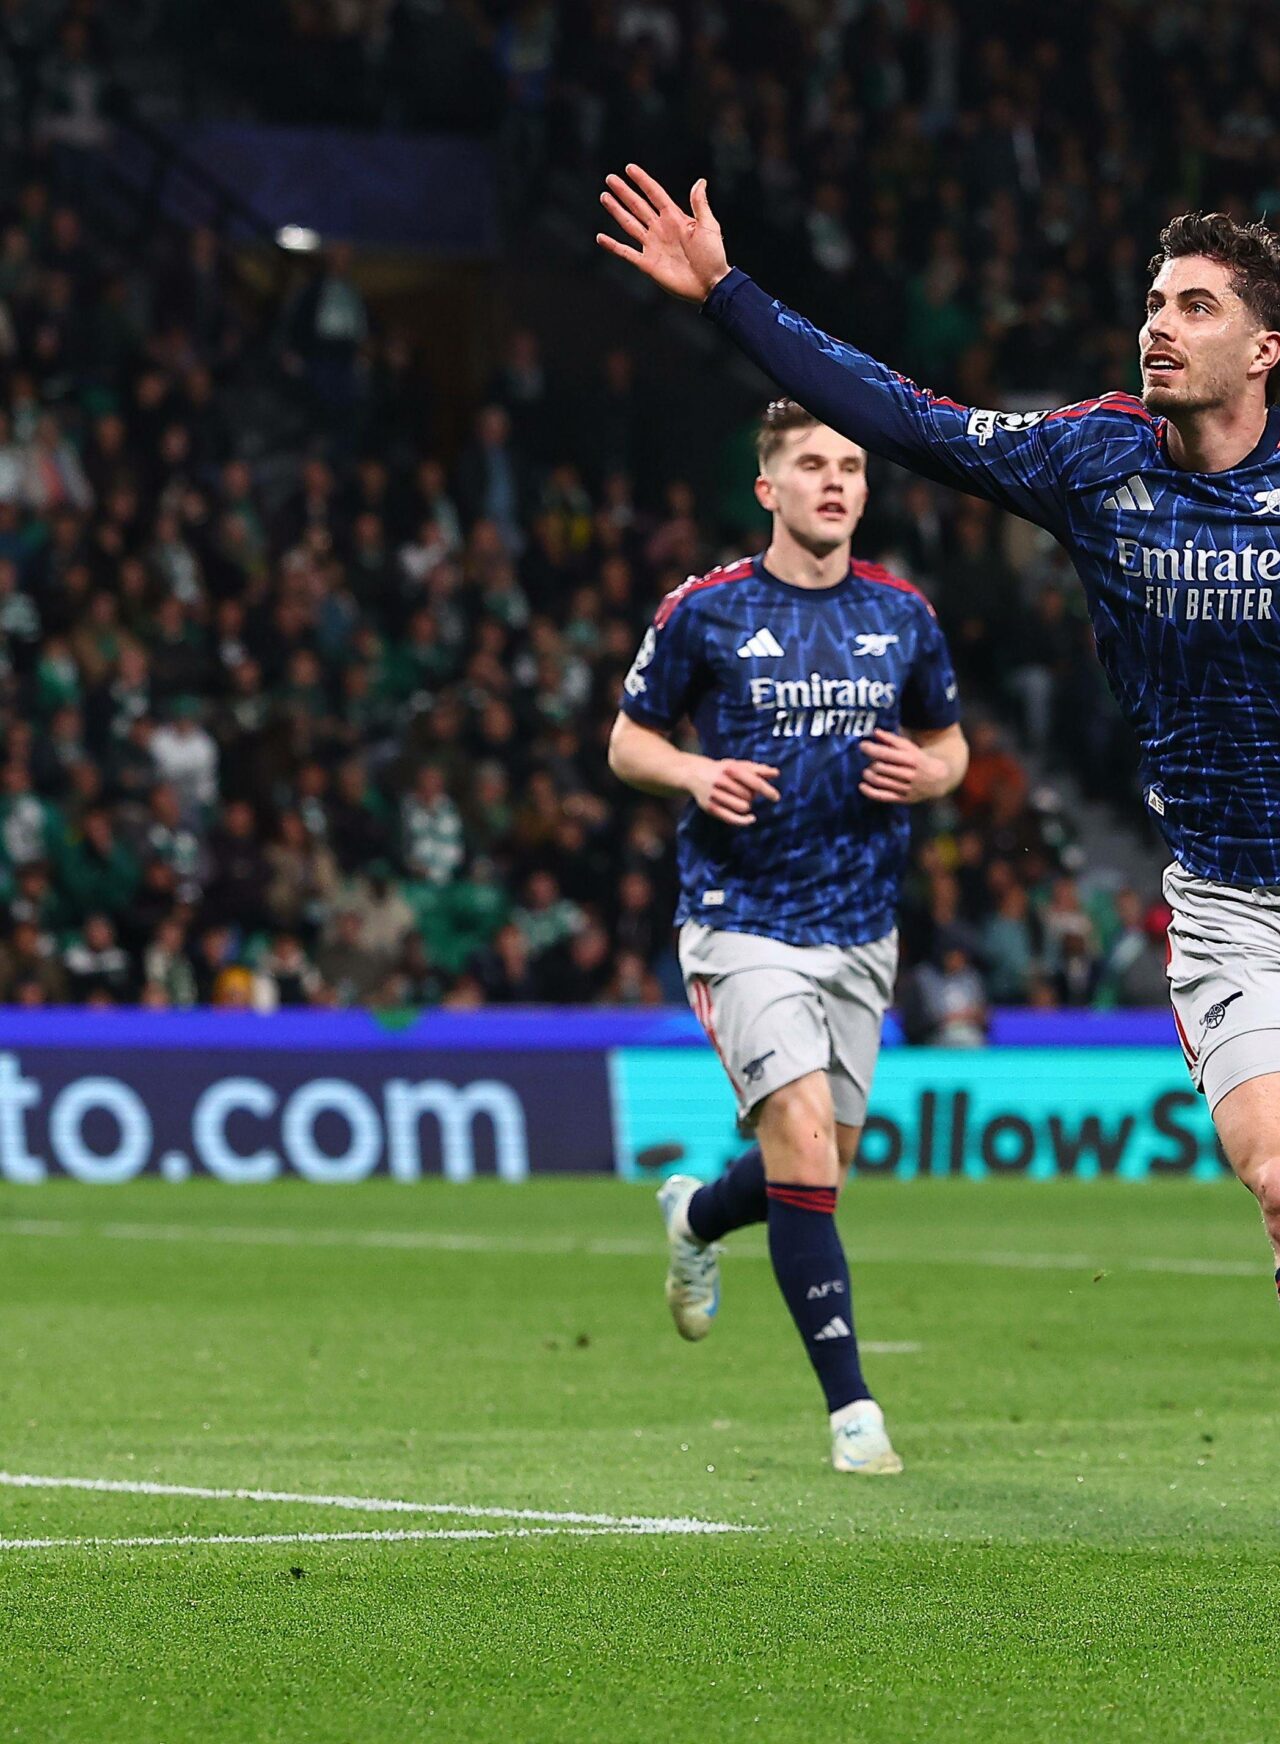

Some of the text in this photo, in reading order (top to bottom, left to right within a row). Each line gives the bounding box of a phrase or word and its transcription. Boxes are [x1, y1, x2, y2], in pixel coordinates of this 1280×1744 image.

[1145, 585, 1272, 620] FLY BETTER
[750, 672, 897, 709] Emirates
